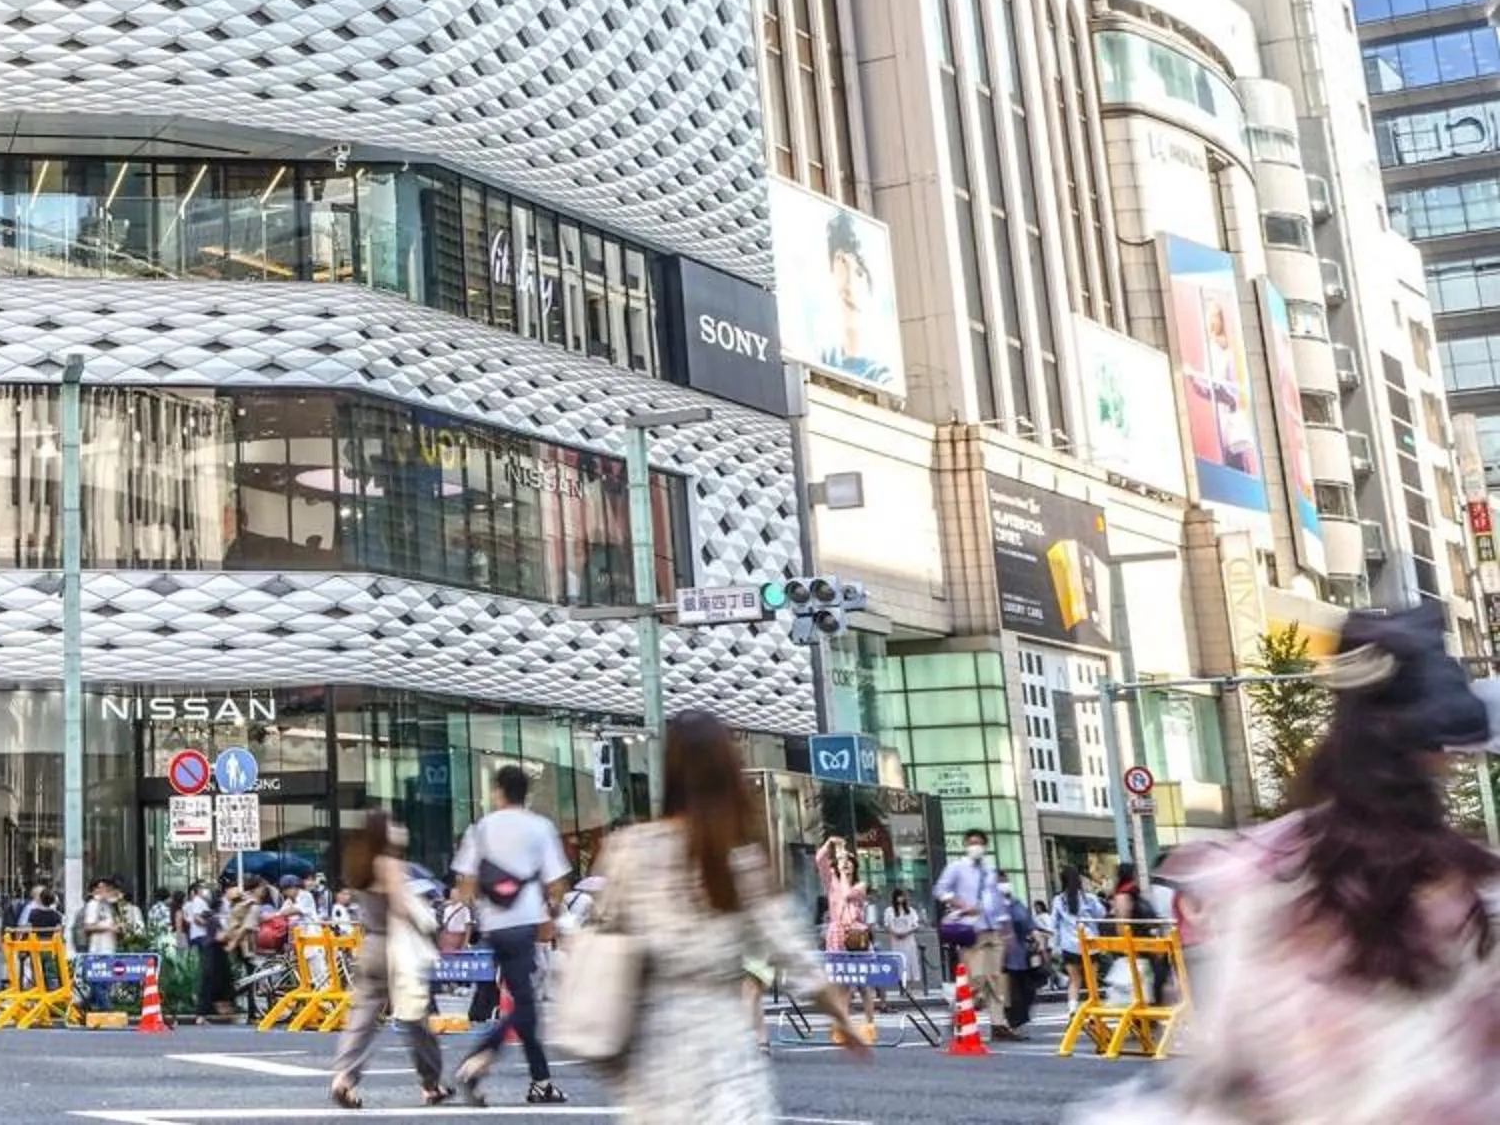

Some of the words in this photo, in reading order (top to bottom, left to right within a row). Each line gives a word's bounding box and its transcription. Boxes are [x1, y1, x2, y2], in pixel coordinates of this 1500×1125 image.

[700, 313, 770, 363] SONY
[504, 457, 584, 500] NISSAN
[100, 696, 278, 722] NISSAN
